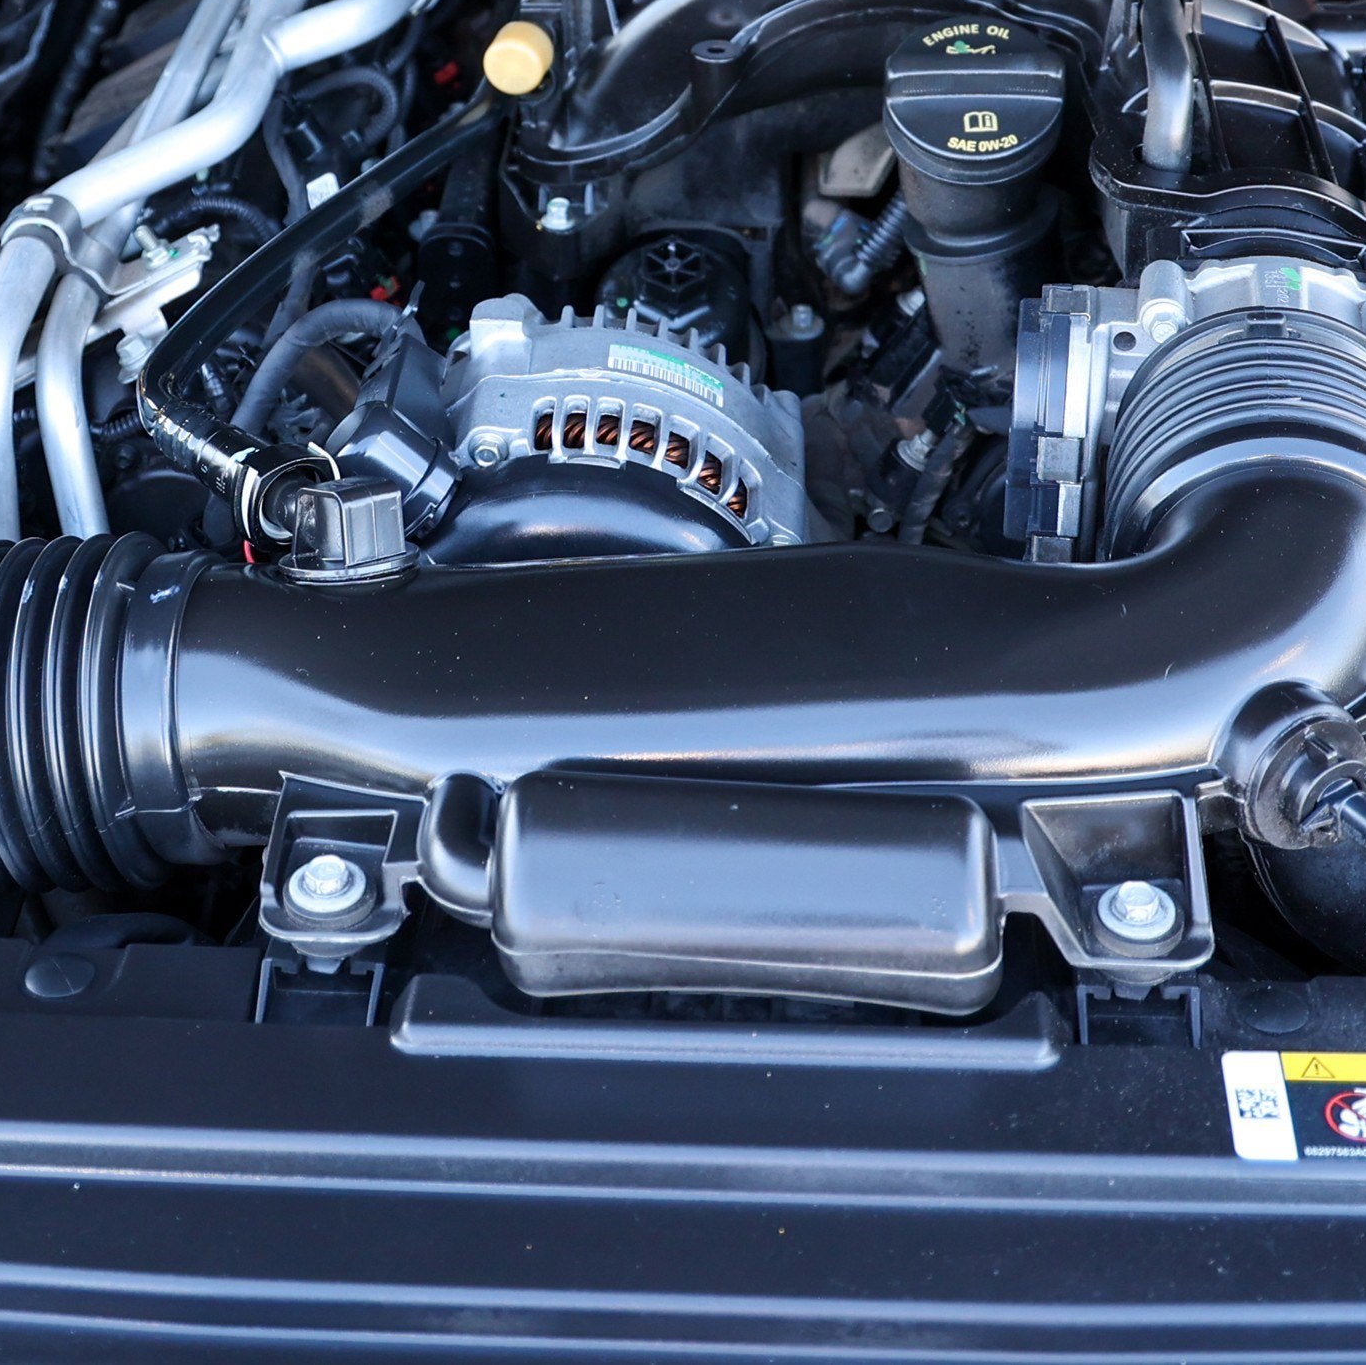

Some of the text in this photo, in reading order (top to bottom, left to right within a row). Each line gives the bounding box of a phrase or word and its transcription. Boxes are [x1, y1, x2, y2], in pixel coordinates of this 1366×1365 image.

[922, 23, 1011, 47] ENGINE OIL
[947, 133, 1018, 152] SAE 0W-20
